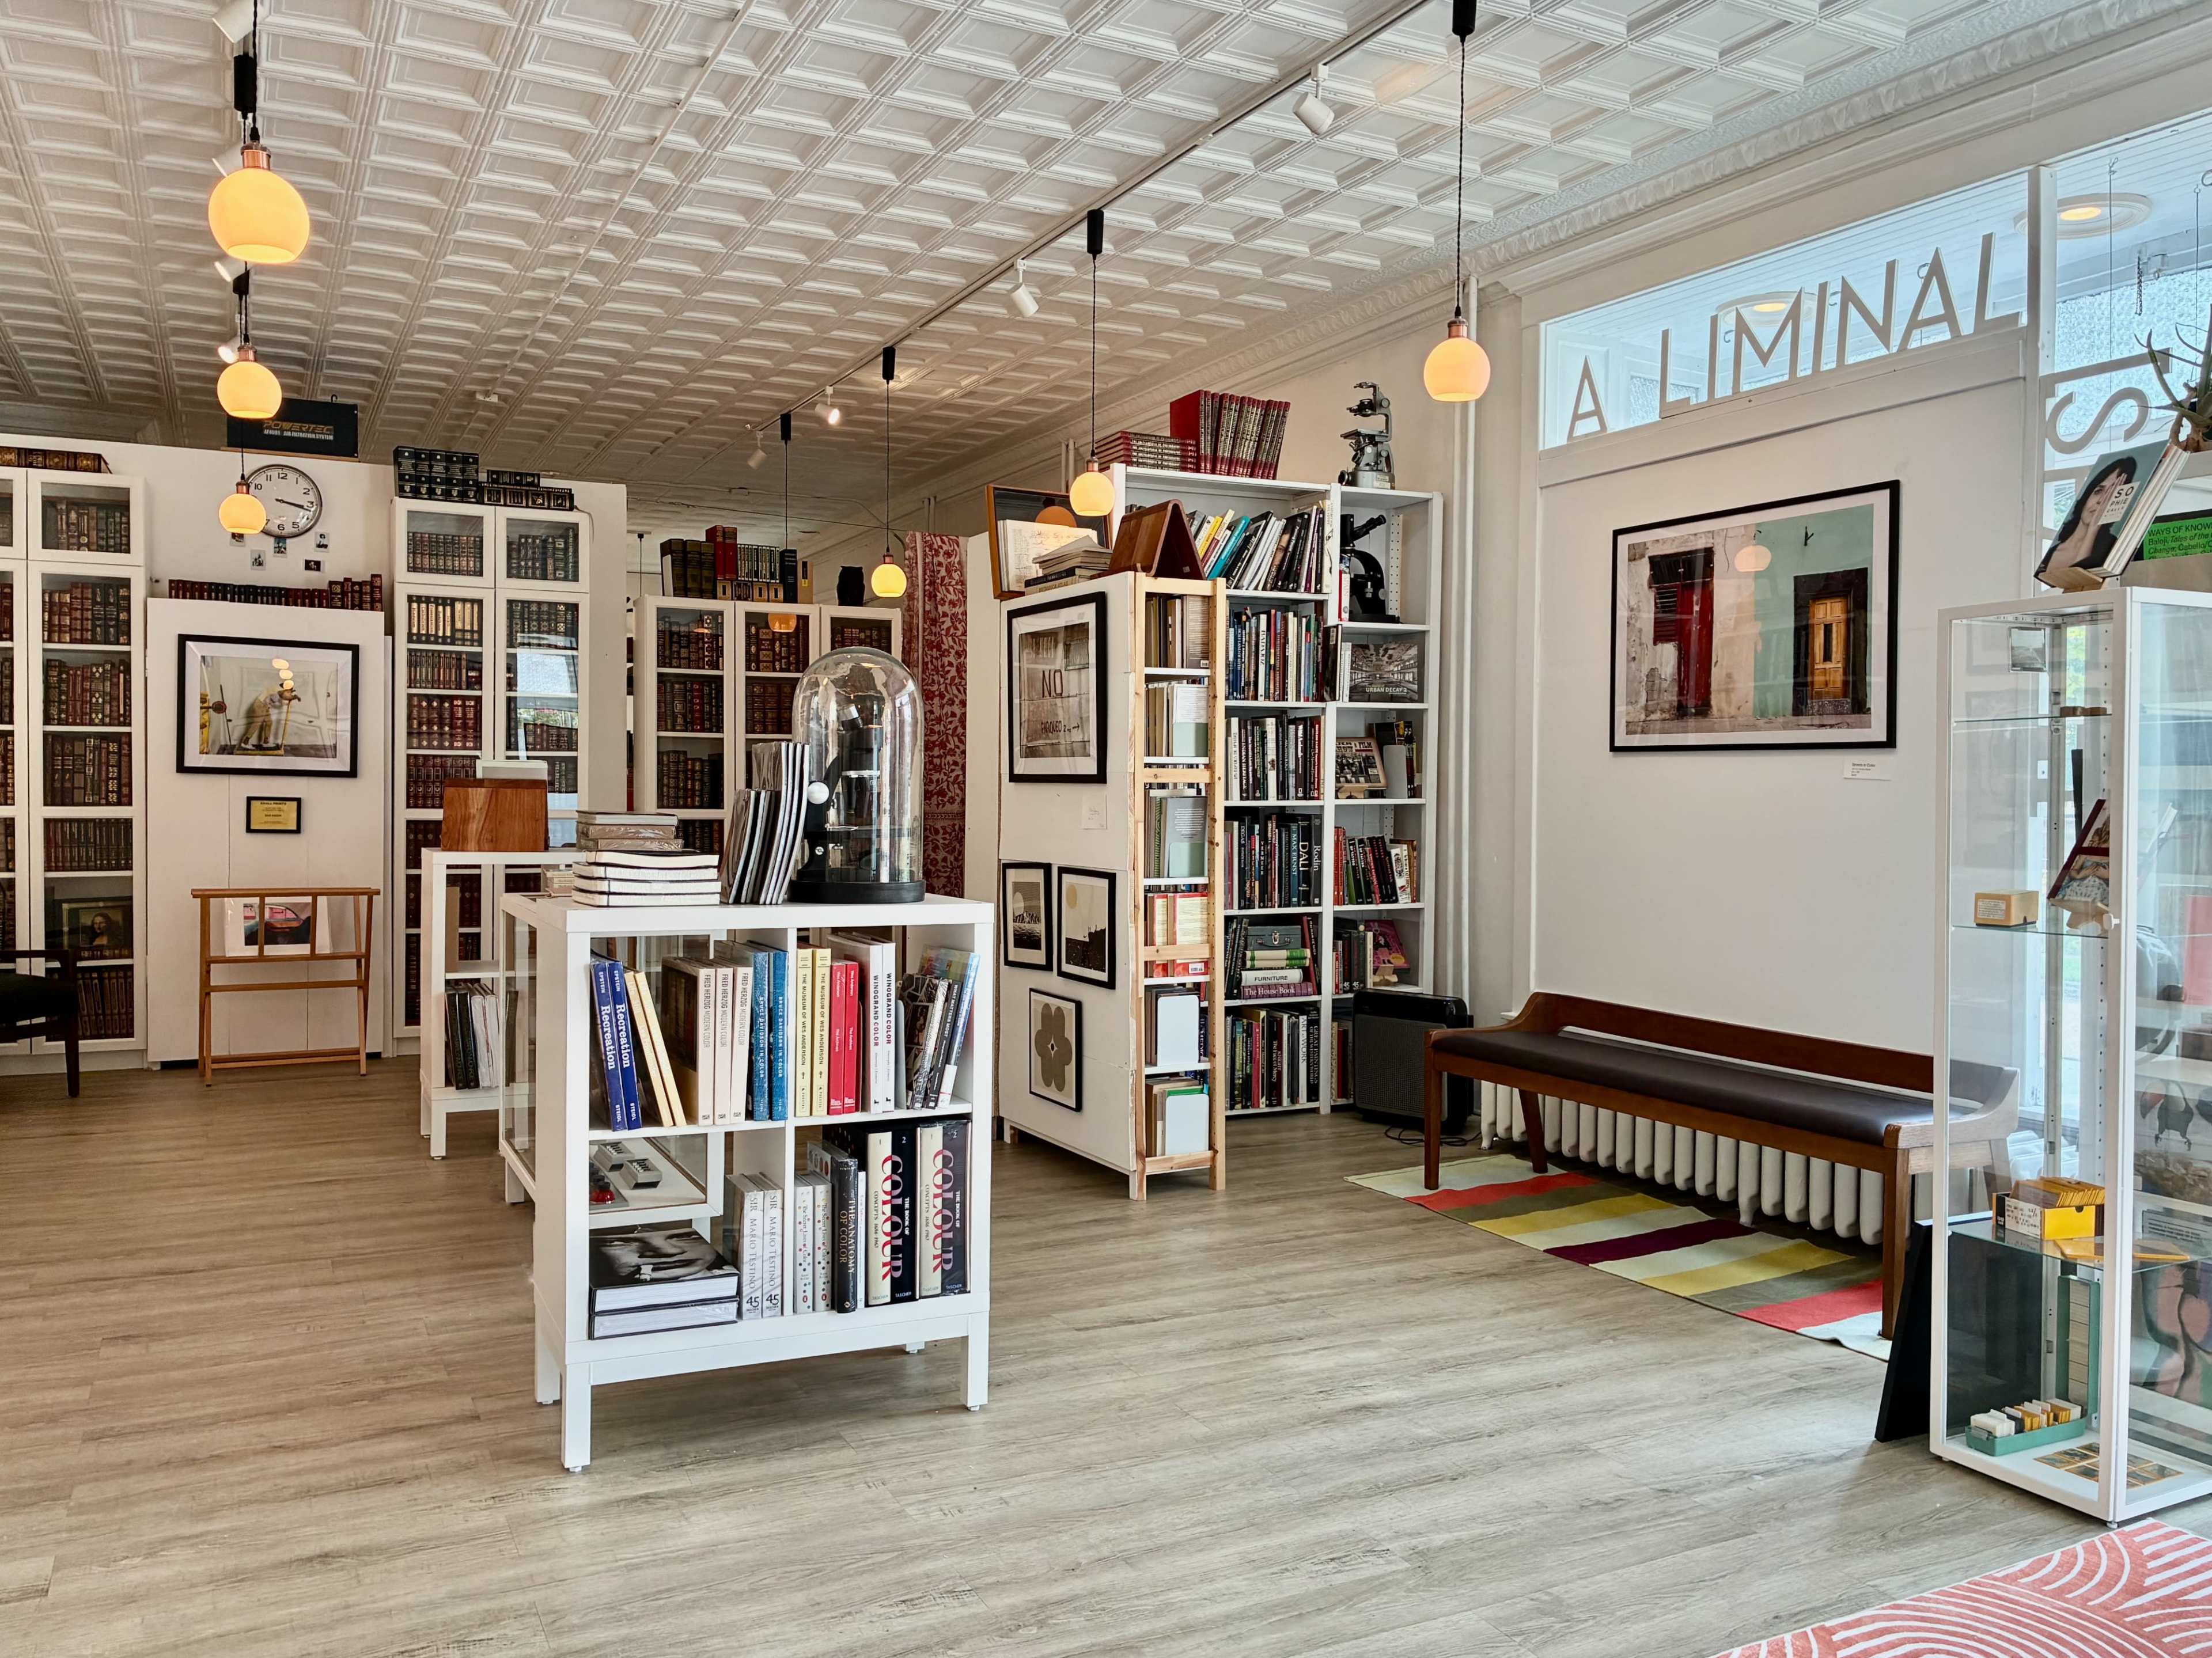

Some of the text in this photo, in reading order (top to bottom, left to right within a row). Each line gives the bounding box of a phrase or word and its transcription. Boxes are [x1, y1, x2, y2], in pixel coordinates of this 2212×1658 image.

[1567, 232, 2024, 443] A LIMINAL
[263, 420, 334, 434] POWERTEC
[2110, 498, 2128, 507] PHIE
[2148, 526, 2171, 537] WAYS
[2172, 525, 2183, 533] OF
[1299, 842, 1309, 871] DALI
[740, 987, 748, 1008] HERZOG
[1244, 986, 1296, 996] The House Book
[738, 1008, 747, 1030] MODERN
[802, 1011, 806, 1019] OF
[820, 1010, 825, 1018] OF
[946, 999, 956, 1022] MATTERS
[601, 1004, 616, 1070] Recreation
[616, 1003, 631, 1068] Recreation
[737, 1030, 745, 1046] COLOR
[881, 1154, 903, 1281] COLOUR
[933, 1149, 954, 1273] COLOUR
[839, 1211, 848, 1263] OF COLOR
[904, 1227, 910, 1235] OF
[749, 1219, 757, 1289] MARIO TESTINO
[768, 1216, 777, 1287] MARIO TESTINO
[747, 1296, 759, 1308] 45
[766, 1293, 779, 1305] 45
